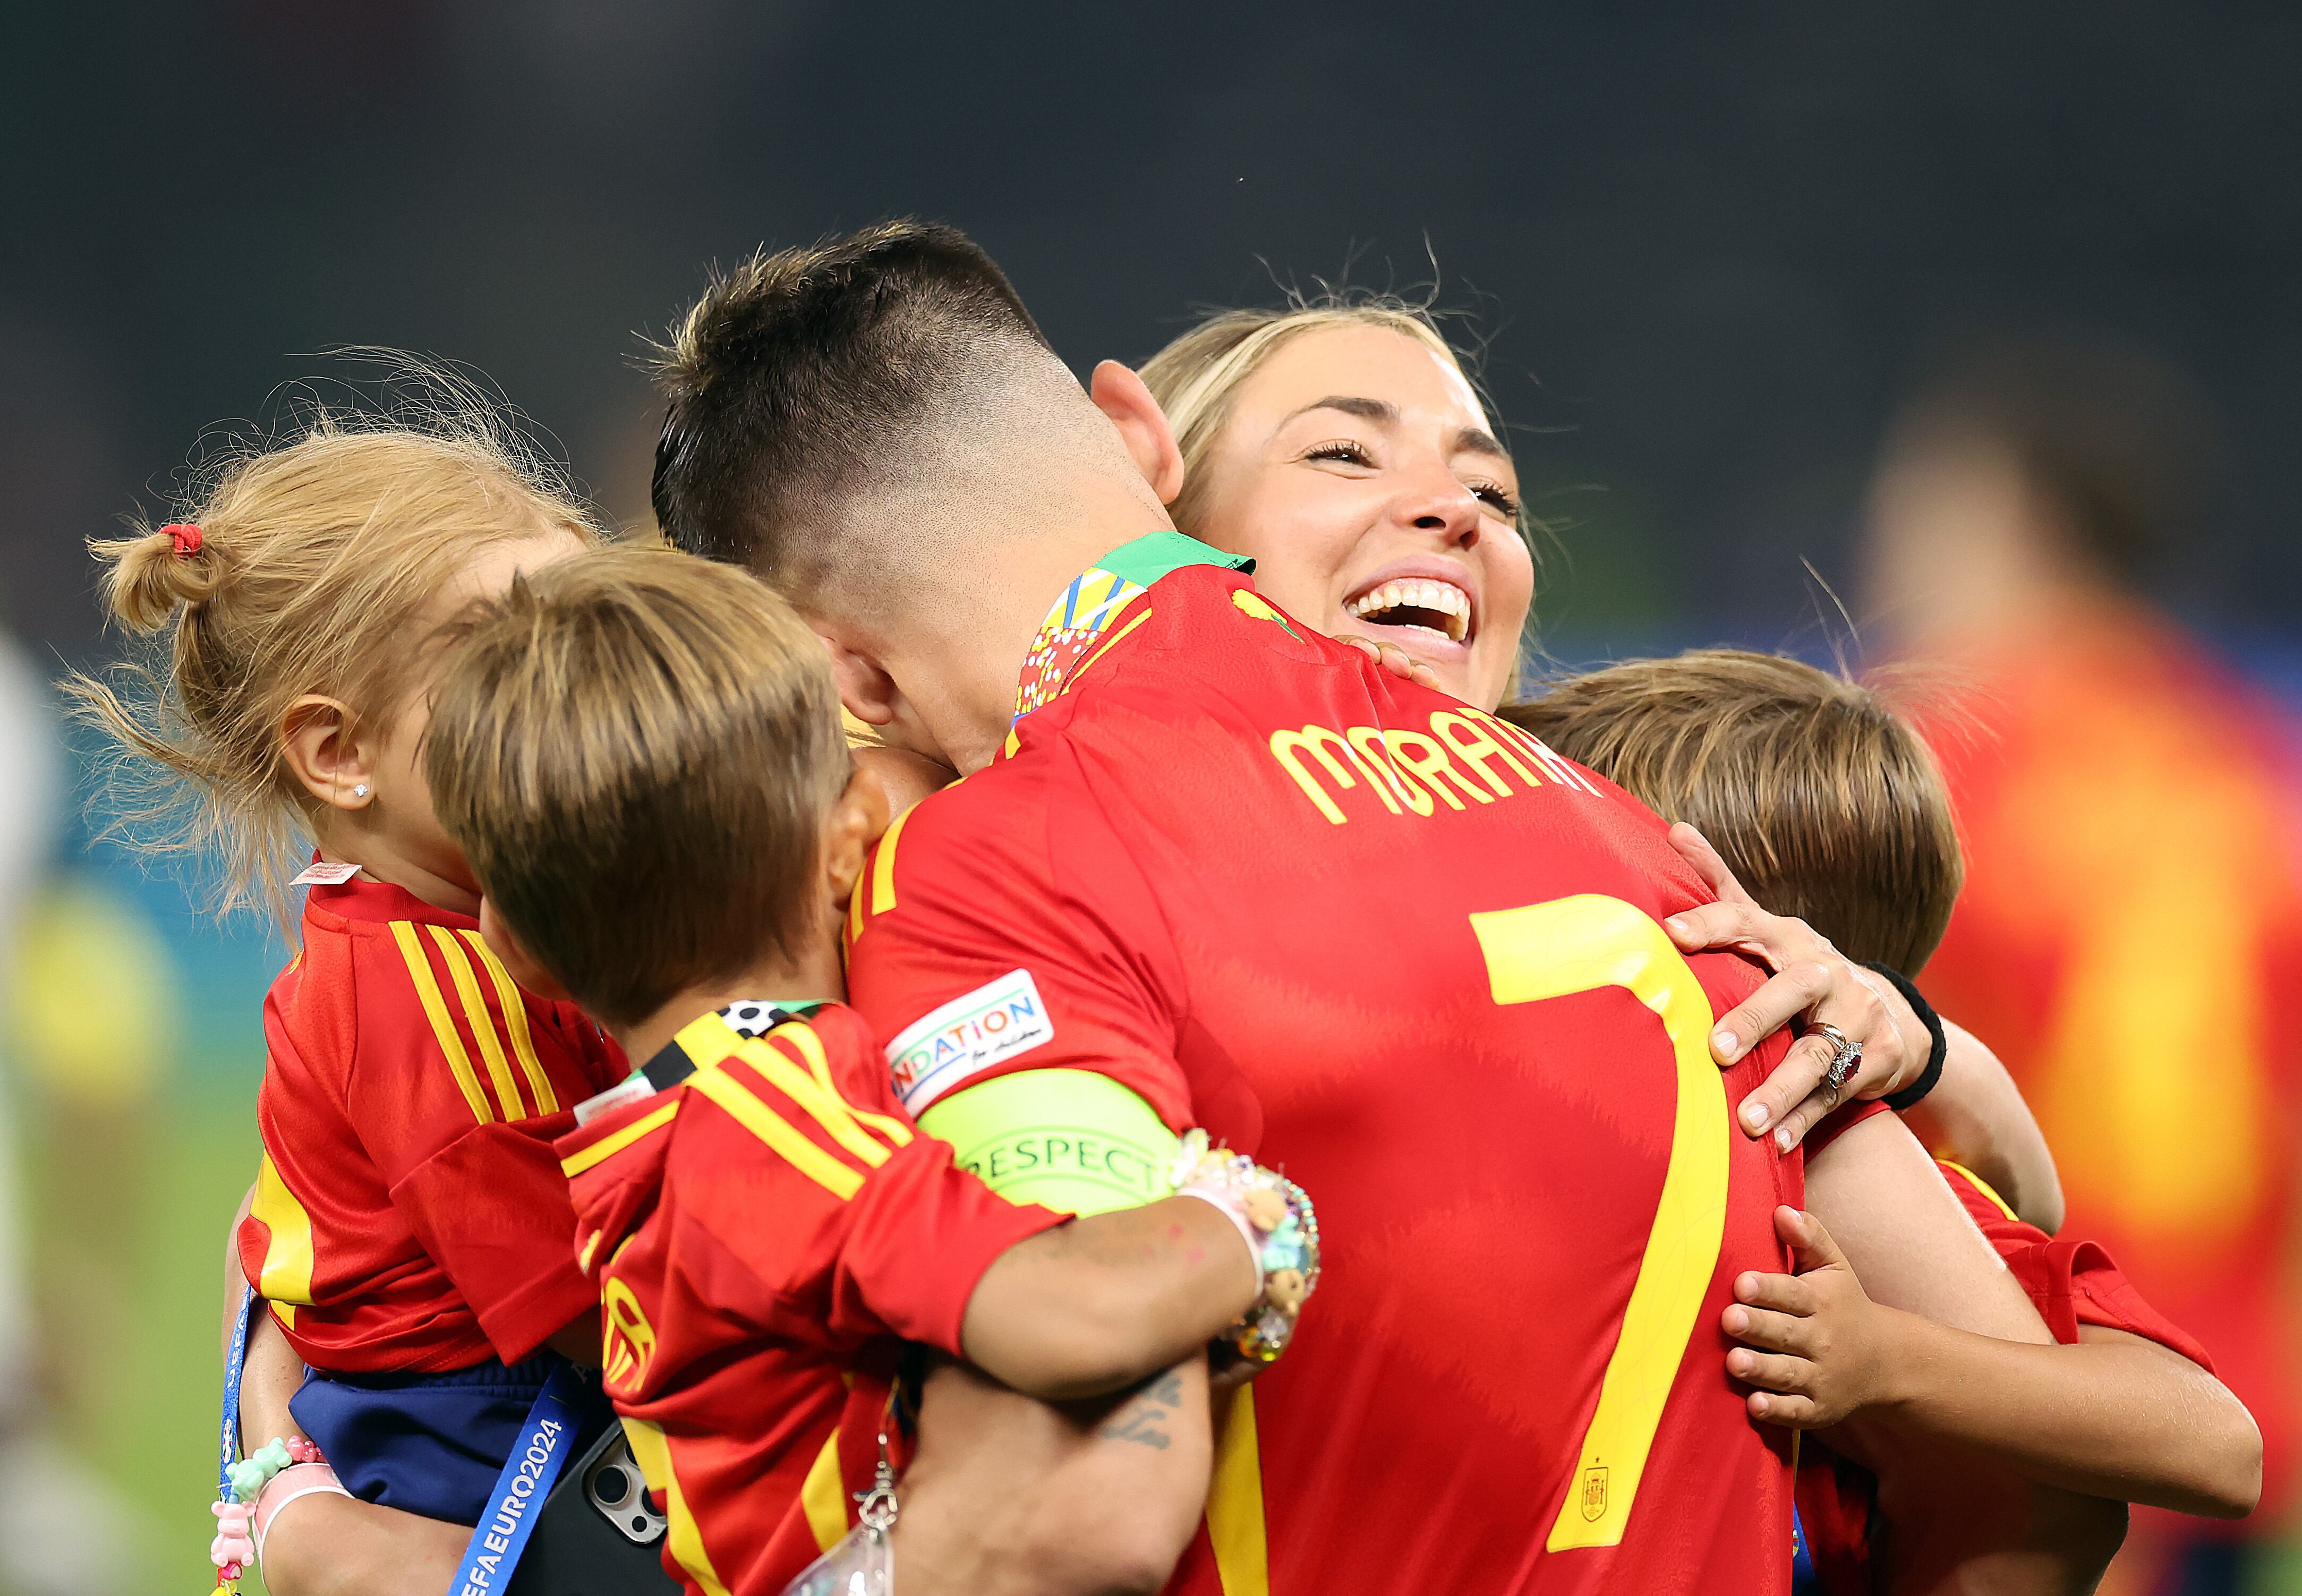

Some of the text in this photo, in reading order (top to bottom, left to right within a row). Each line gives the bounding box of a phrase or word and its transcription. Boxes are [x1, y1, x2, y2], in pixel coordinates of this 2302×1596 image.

[1270, 707, 1604, 825] MORATA
[891, 996, 1035, 1093] NDATION
[1469, 893, 1730, 1552] 7
